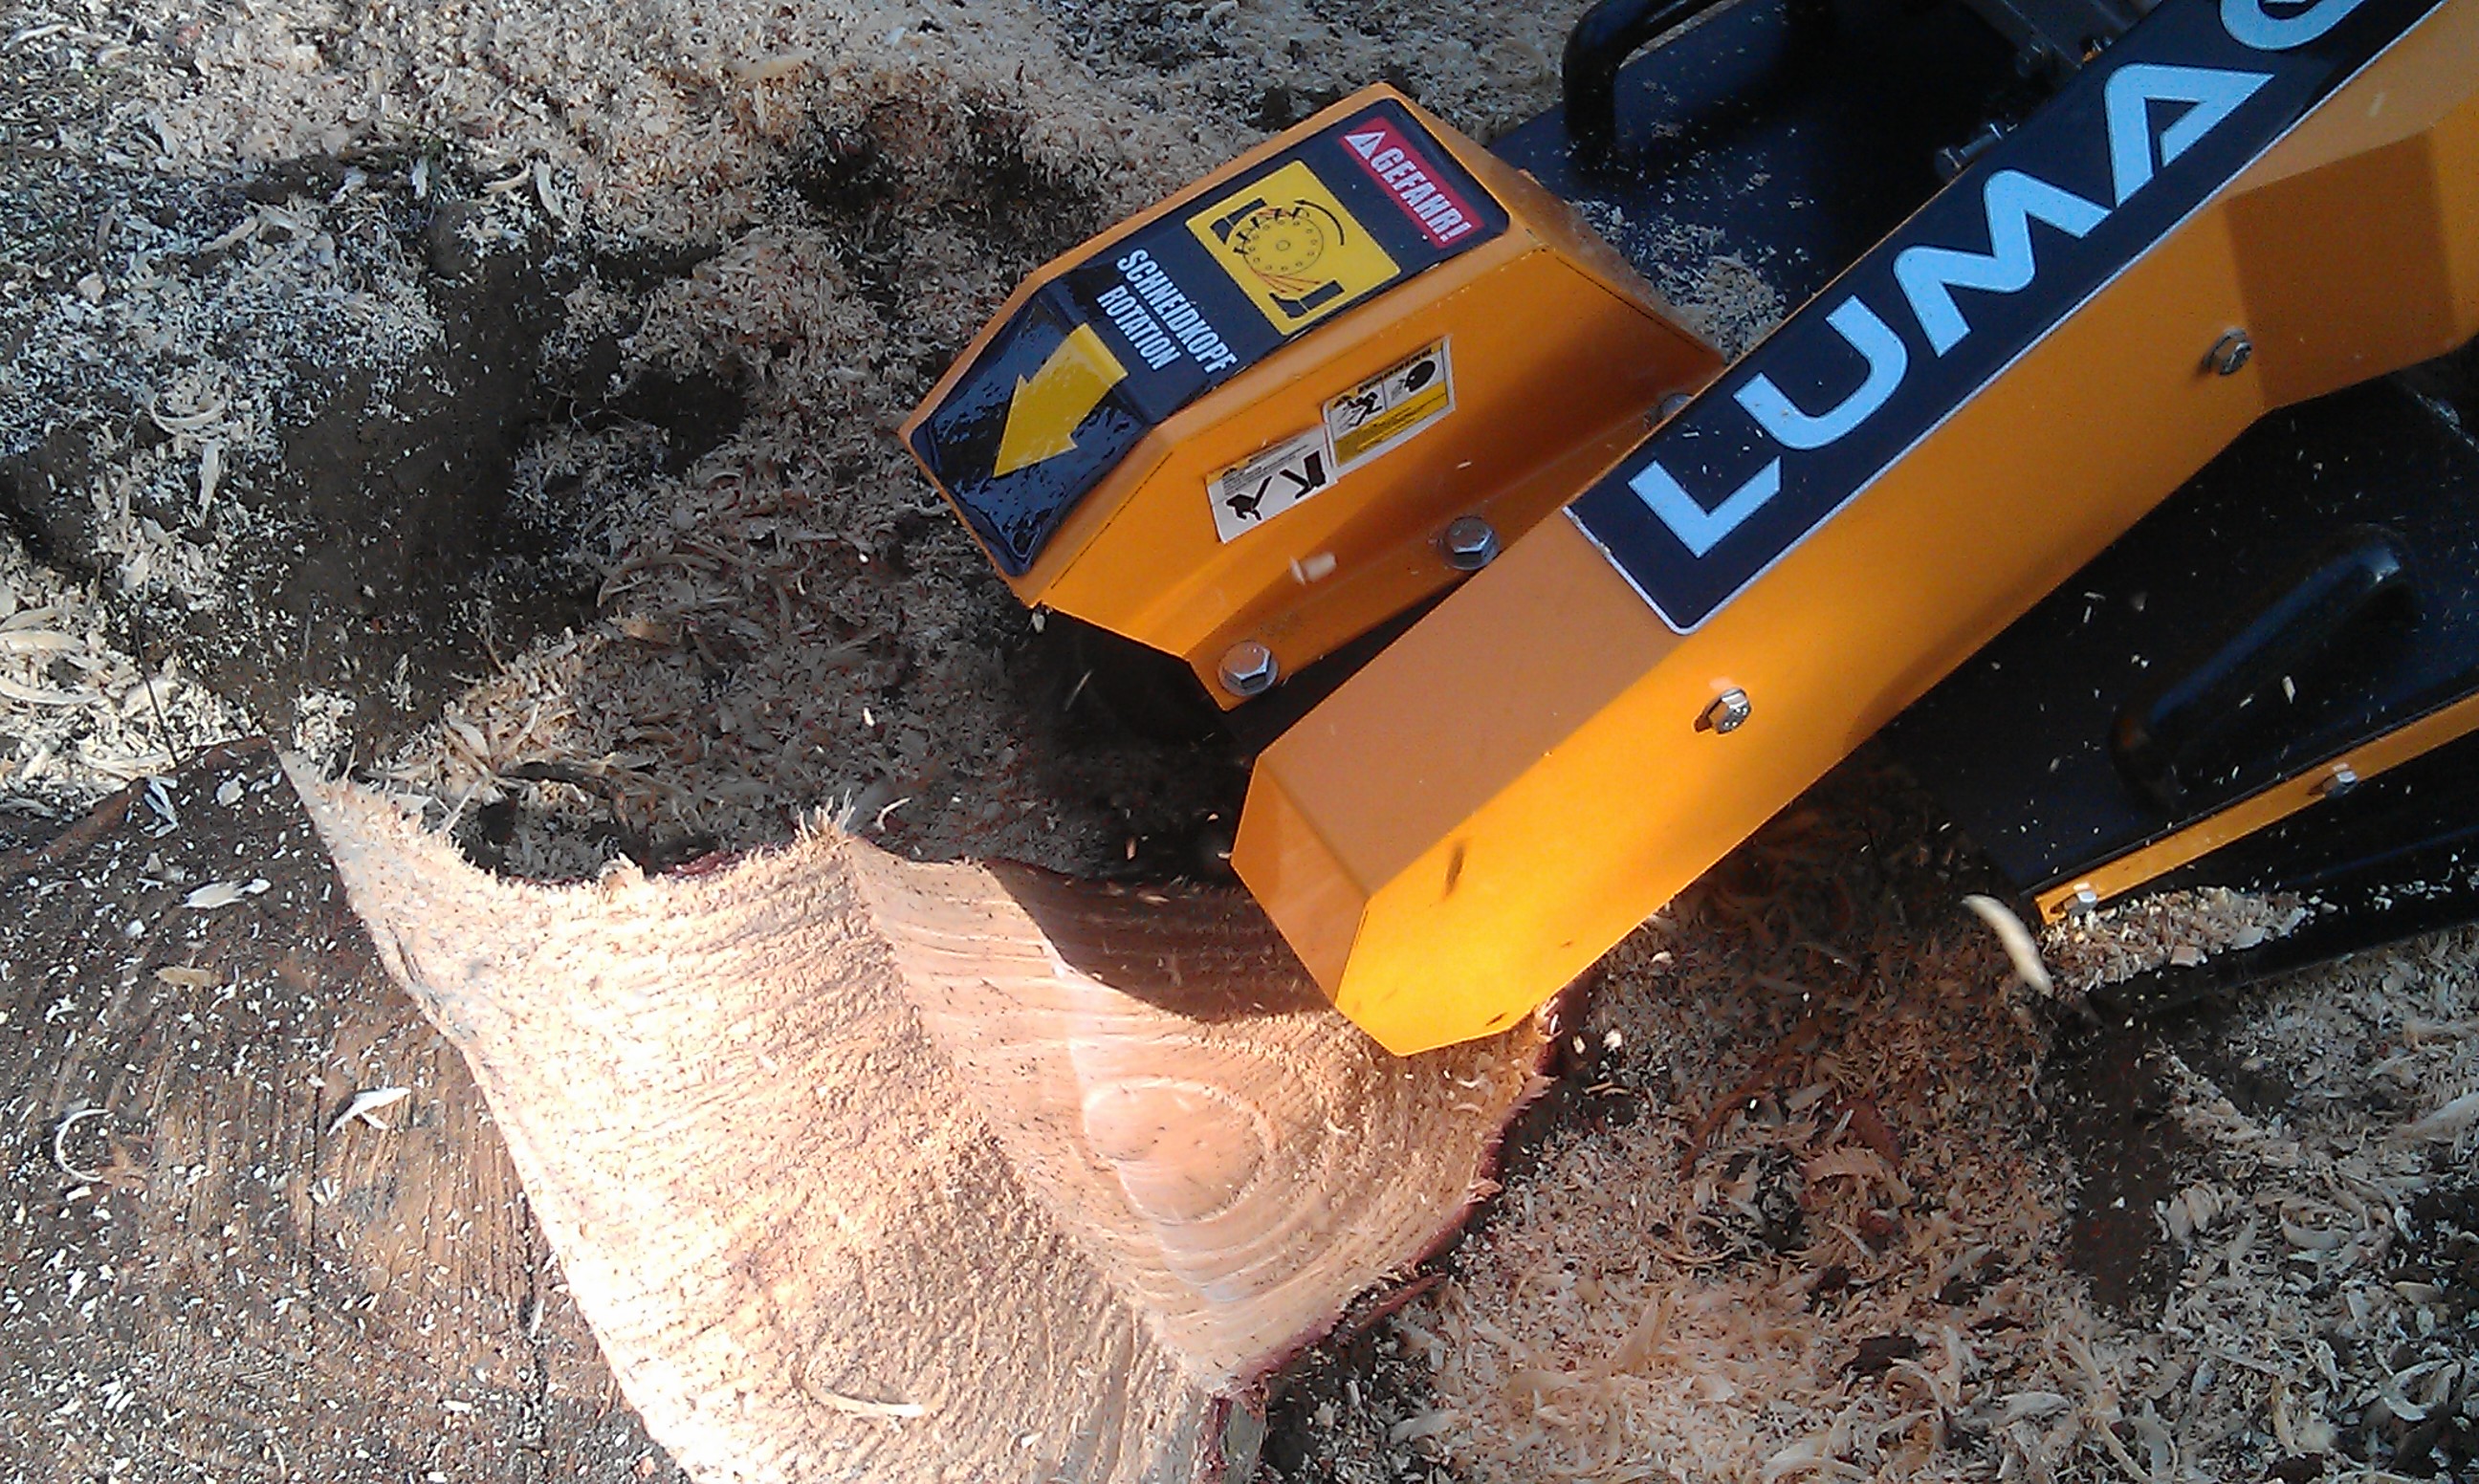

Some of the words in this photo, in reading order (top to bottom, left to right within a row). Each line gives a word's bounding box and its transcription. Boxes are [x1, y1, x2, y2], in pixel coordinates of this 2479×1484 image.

[1370, 146, 1473, 243] GEFAHR!
[1096, 285, 1182, 370] ROTATION
[1116, 249, 1239, 374] SCHNEIDKOPF
